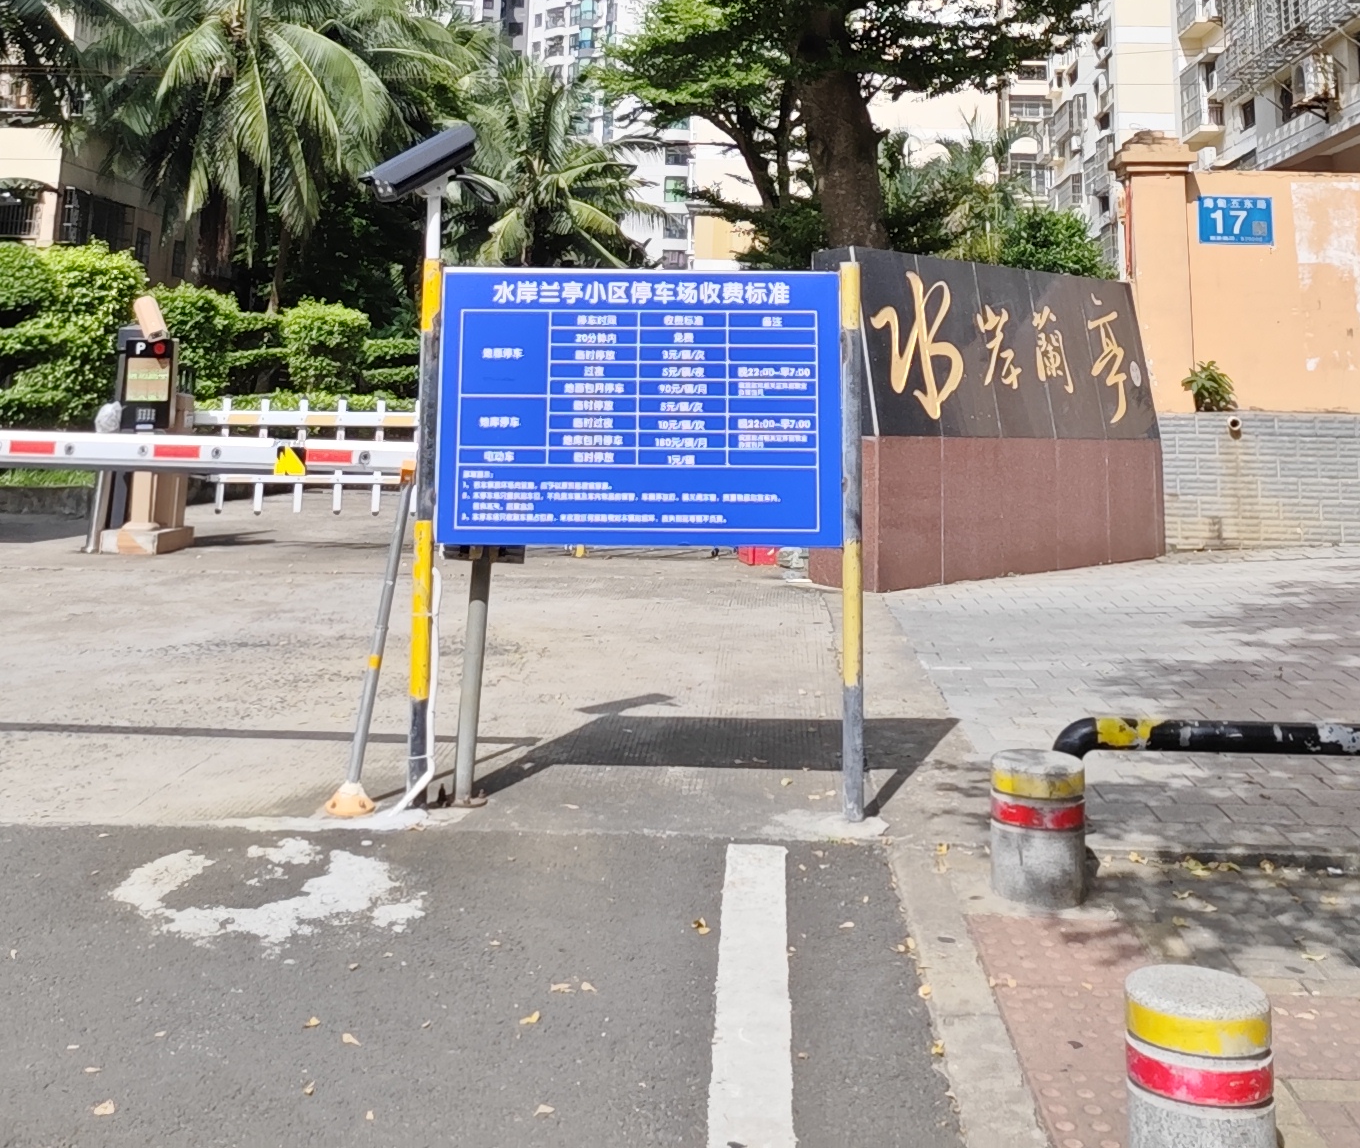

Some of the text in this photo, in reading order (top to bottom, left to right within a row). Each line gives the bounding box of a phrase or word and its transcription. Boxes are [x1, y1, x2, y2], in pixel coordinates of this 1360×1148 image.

[1210, 209, 1248, 235] 17
[493, 281, 789, 304] 水岸兰亭小区停车场收费标准
[135, 342, 146, 354] P
